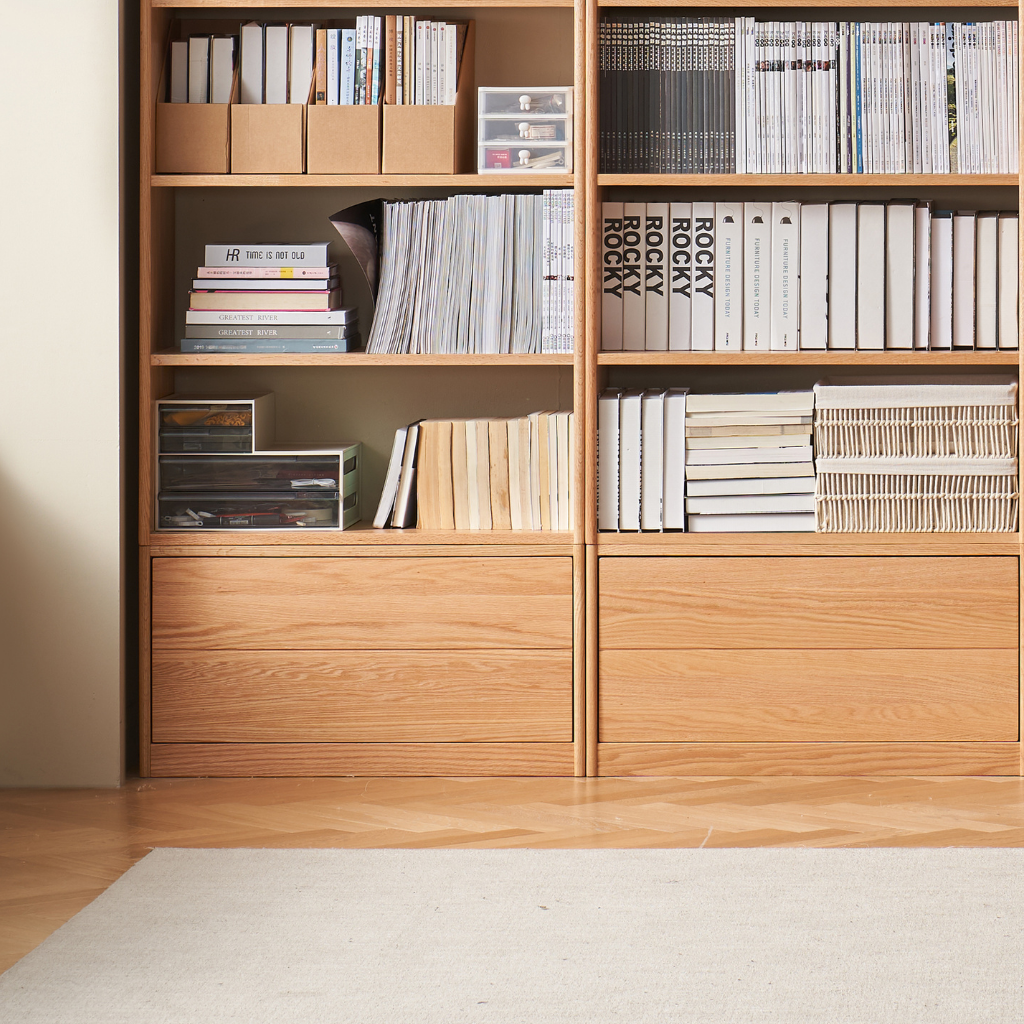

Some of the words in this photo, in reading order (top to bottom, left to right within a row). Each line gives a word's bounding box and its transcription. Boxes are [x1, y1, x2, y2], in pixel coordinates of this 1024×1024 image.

[604, 218, 622, 298] ROCKY
[623, 216, 641, 296] ROCKY
[646, 216, 664, 296] ROCKY
[672, 218, 690, 298] ROCKY
[695, 218, 713, 298] ROCKY
